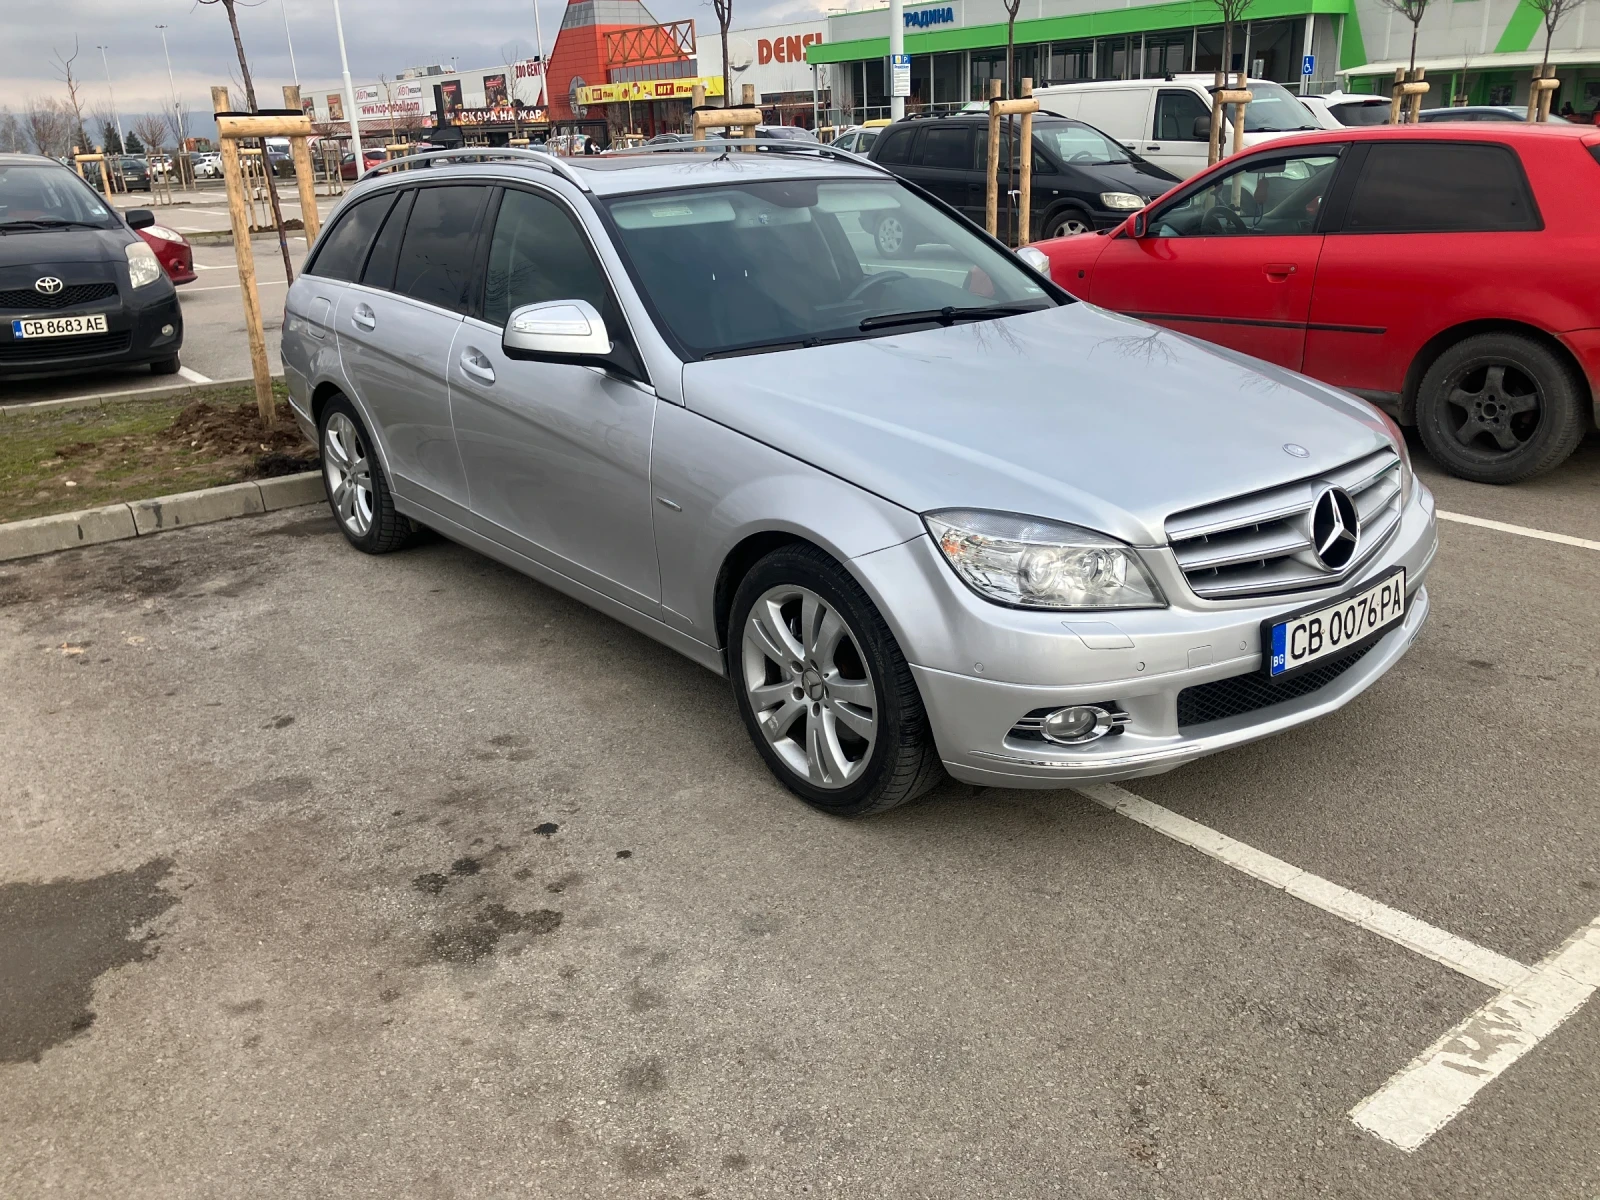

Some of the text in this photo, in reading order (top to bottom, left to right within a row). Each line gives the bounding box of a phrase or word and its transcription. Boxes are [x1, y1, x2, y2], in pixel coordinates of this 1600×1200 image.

[903, 7, 954, 28] РАДИНА
[657, 84, 672, 95] HIT
[461, 111, 497, 122] СКАРА
[499, 110, 514, 121] НА
[518, 109, 542, 120] ЖАР
[24, 317, 104, 336] CB 8683 AE
[1290, 579, 1401, 660] CB 0076 PA
[1273, 654, 1284, 667] BG
